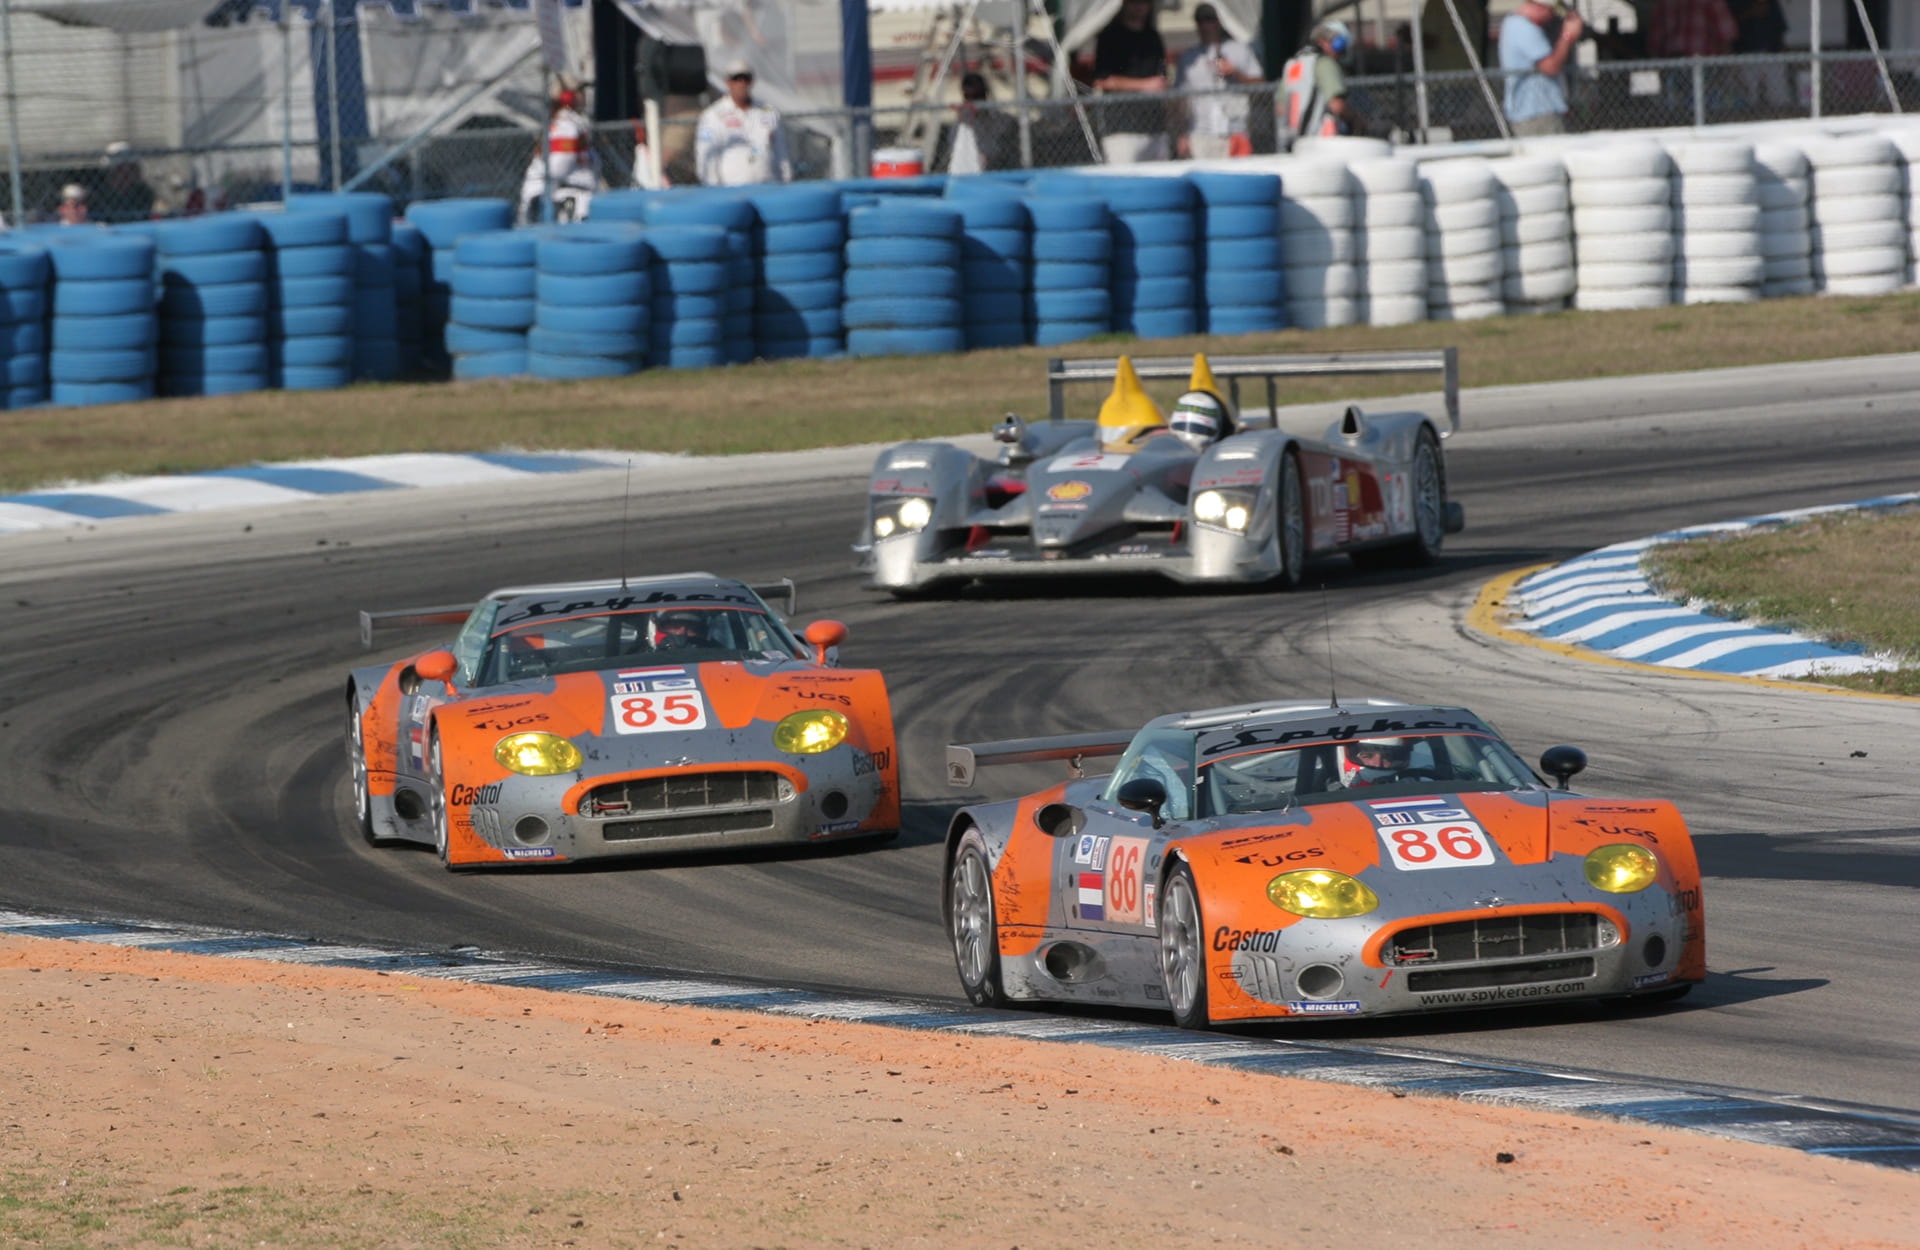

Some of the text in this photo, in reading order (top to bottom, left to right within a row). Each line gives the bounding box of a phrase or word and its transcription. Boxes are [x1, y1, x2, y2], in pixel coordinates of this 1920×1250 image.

[798, 690, 852, 706] UGS
[496, 713, 550, 731] UGS
[621, 695, 699, 727] 85
[451, 782, 503, 806] Castrol
[1391, 826, 1482, 863] 86
[1600, 825, 1659, 843] UGS
[1262, 848, 1324, 867] UGS
[1110, 845, 1139, 912] 86
[1213, 926, 1282, 953] Castrol
[1420, 981, 1586, 1005] www.spykercars.com
[1305, 1003, 1357, 1012] MICHELIN
